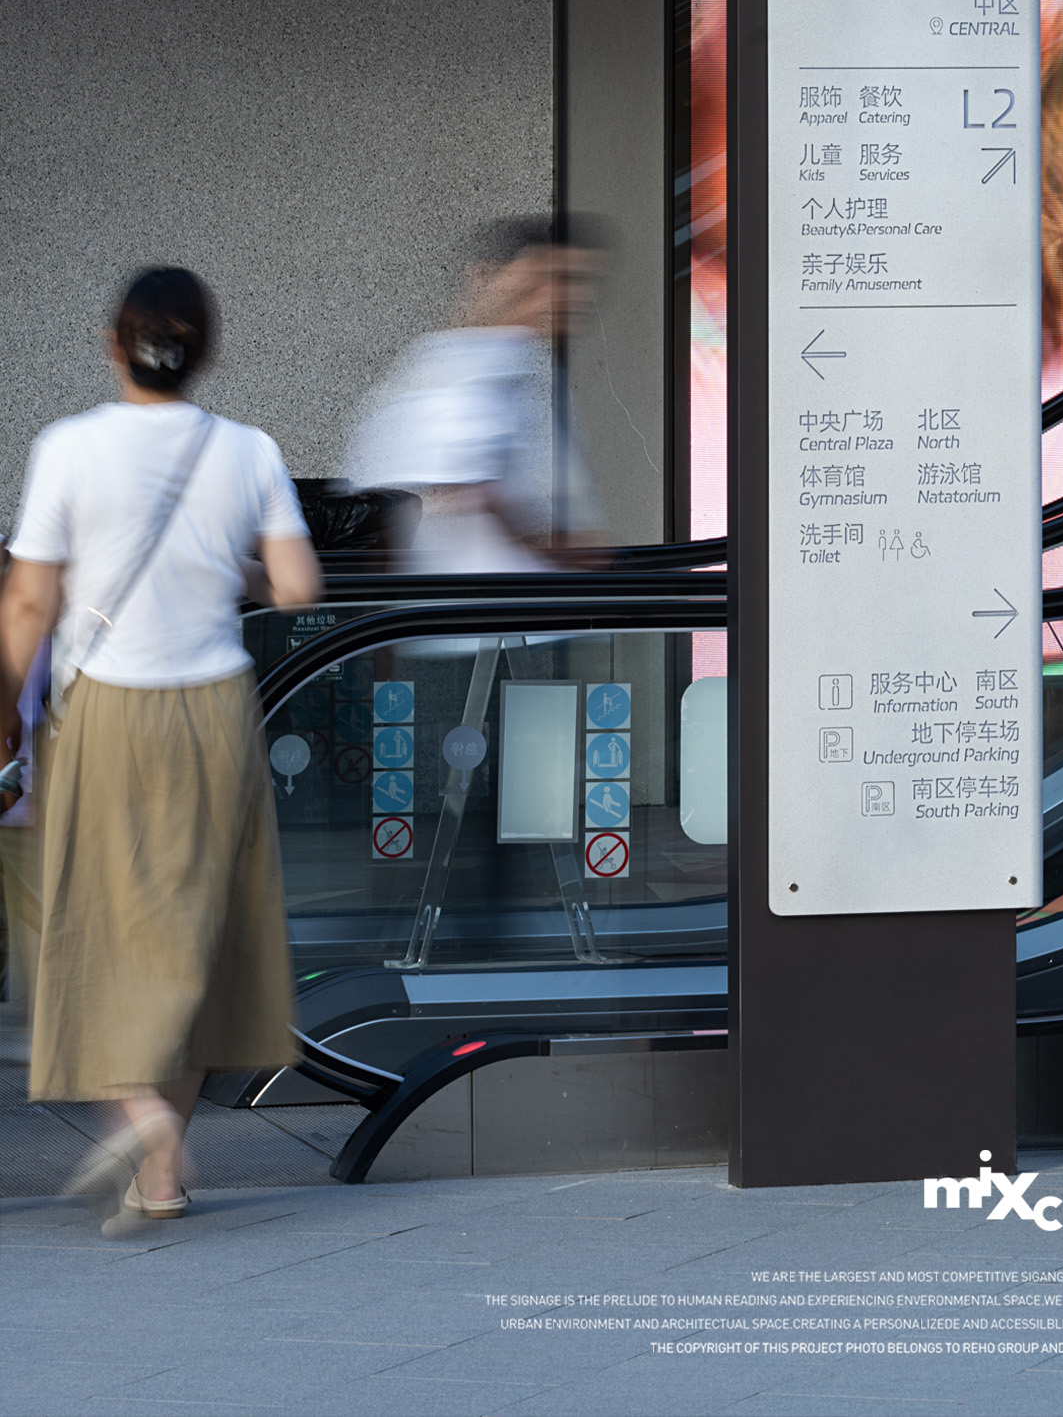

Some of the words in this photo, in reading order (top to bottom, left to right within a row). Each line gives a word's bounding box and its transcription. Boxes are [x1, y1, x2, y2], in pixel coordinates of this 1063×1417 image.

[950, 22, 1019, 35] CENTRAL
[799, 86, 842, 108] 服饰
[860, 86, 902, 108] 餐饮
[964, 89, 1016, 128] L2
[800, 112, 847, 126] Apparel
[859, 112, 910, 126] Catering
[800, 143, 842, 165] 儿童
[860, 143, 902, 165] 服务
[799, 169, 825, 181] Kids
[860, 169, 909, 180] Services
[802, 198, 888, 220] 个人护理
[802, 223, 911, 238] Beauty&Personal
[915, 223, 942, 234] Care
[803, 253, 888, 275] 亲子娱乐
[802, 279, 842, 293] Family
[846, 279, 922, 290] Amusement
[800, 410, 883, 433] 中央广场
[918, 409, 960, 431] 北区
[800, 437, 851, 451] Central
[856, 437, 893, 450] Plaza
[918, 435, 959, 449] North
[800, 464, 865, 487] 体育馆
[918, 462, 981, 485] 游泳馆
[800, 491, 887, 509] Gymnasium
[918, 489, 1000, 503] Natatorium
[800, 523, 863, 545] 洗手间
[800, 549, 840, 563] Toilet
[296, 615, 336, 626] 其他垃圾
[870, 671, 957, 695] 服务中心
[976, 669, 1018, 691] 南区
[874, 698, 957, 713] Information
[975, 695, 1018, 709] South
[911, 720, 1019, 744] 地下停车场
[829, 747, 850, 759] 地下
[864, 748, 960, 767] Underground
[964, 747, 1019, 764] Parking
[912, 775, 1018, 800] 南区停车场
[871, 801, 891, 813] 南区
[916, 804, 959, 818] South
[965, 802, 1018, 819] Parking
